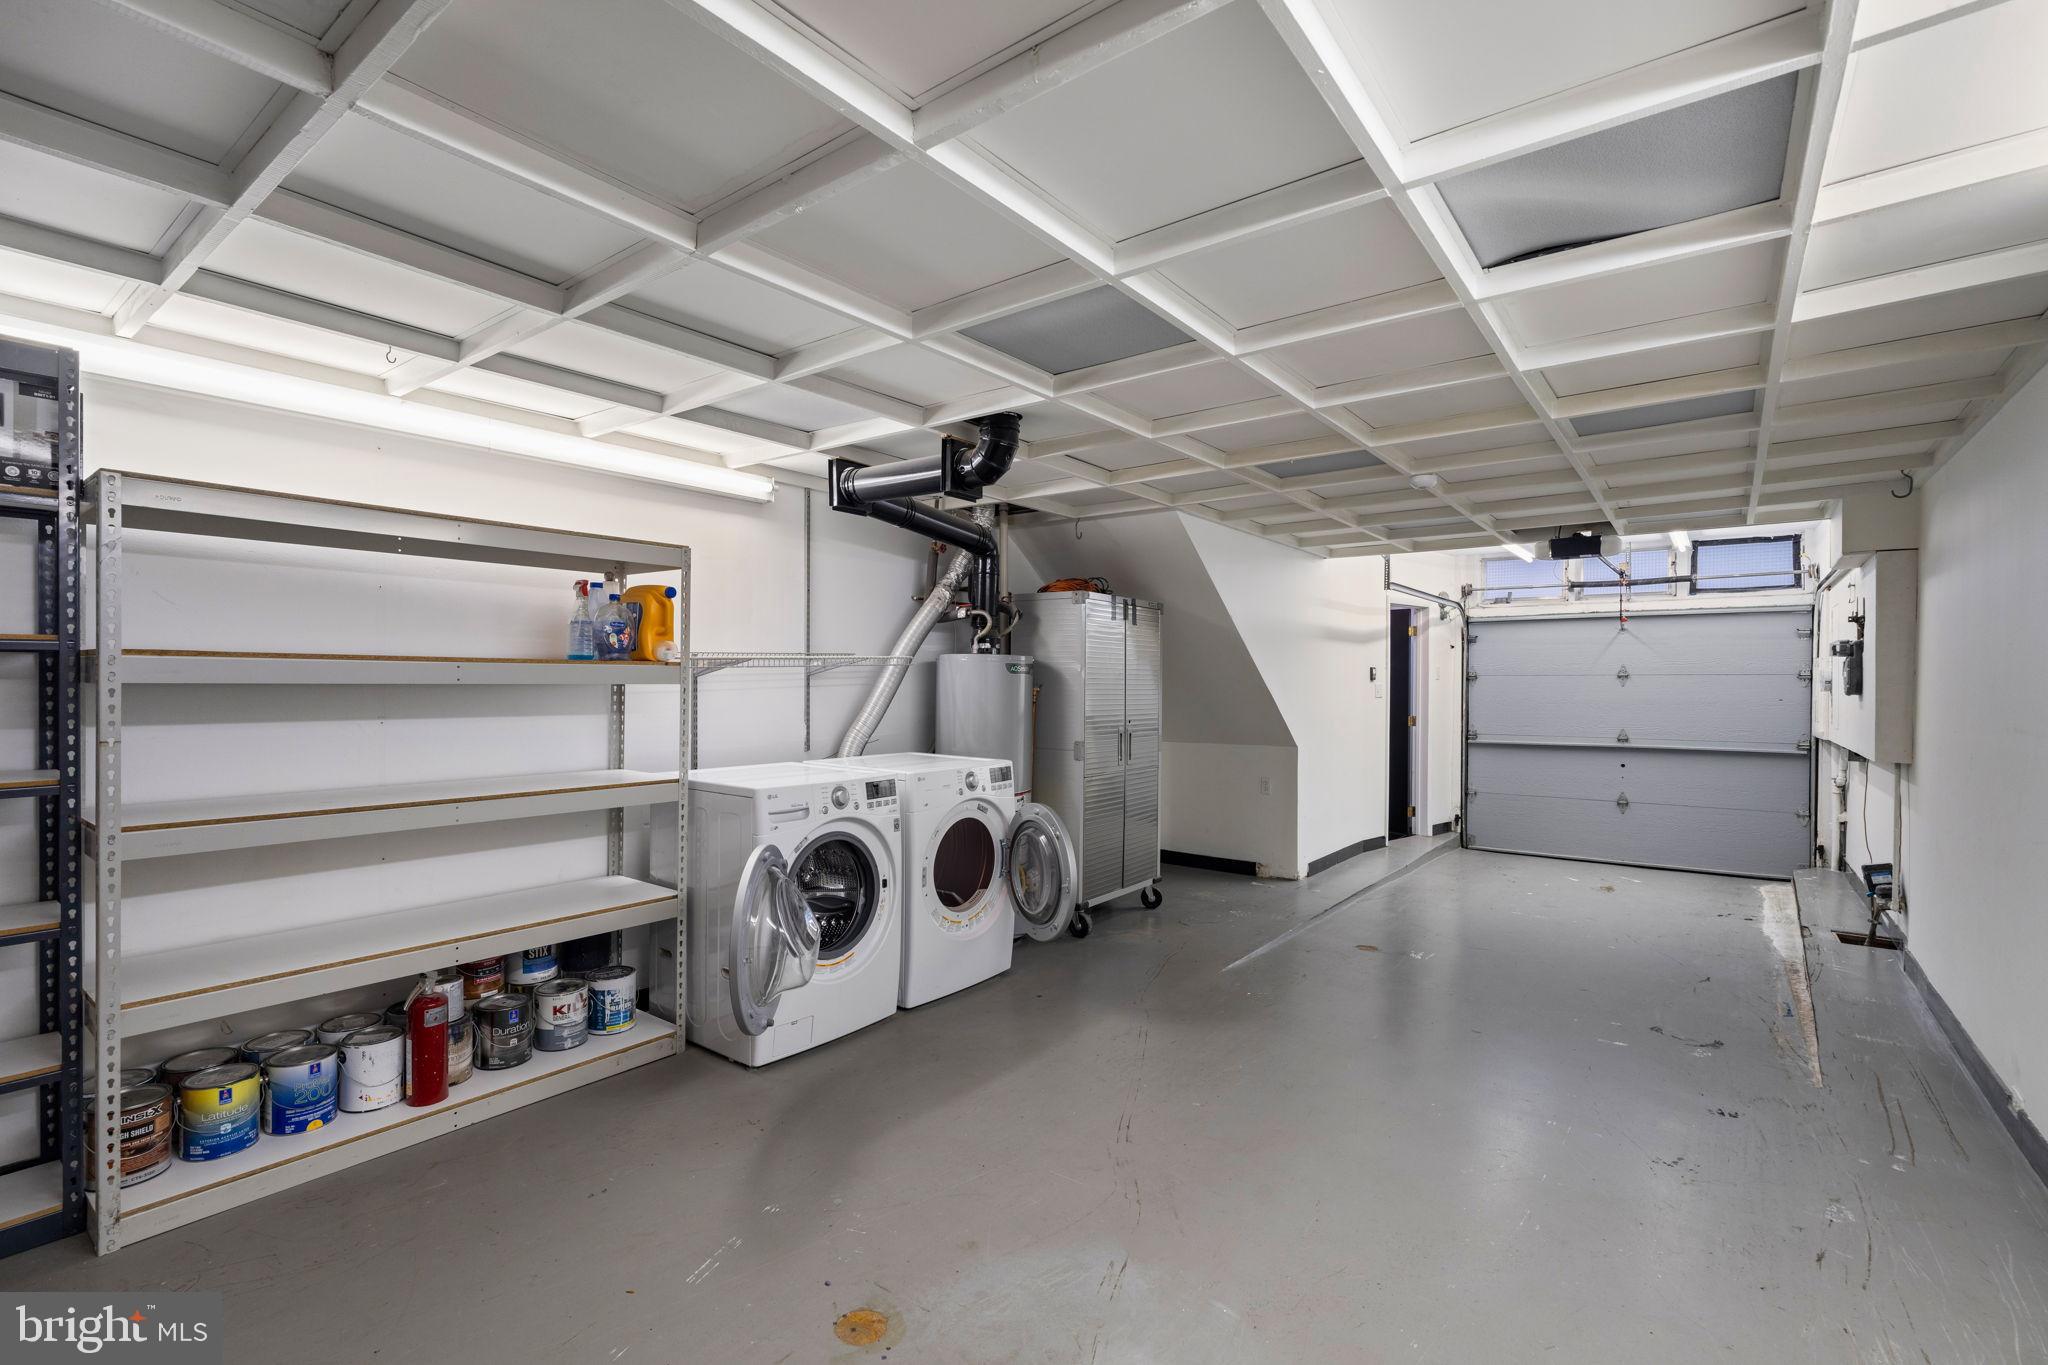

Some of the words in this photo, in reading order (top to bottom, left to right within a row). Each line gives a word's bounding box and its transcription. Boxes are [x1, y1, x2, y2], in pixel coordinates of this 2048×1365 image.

[528, 945, 549, 959] STIX
[492, 1020, 530, 1037] Duration
[294, 1083, 332, 1105] 200
[201, 1103, 248, 1122] Latitude
[130, 1123, 154, 1138] SHIELD
